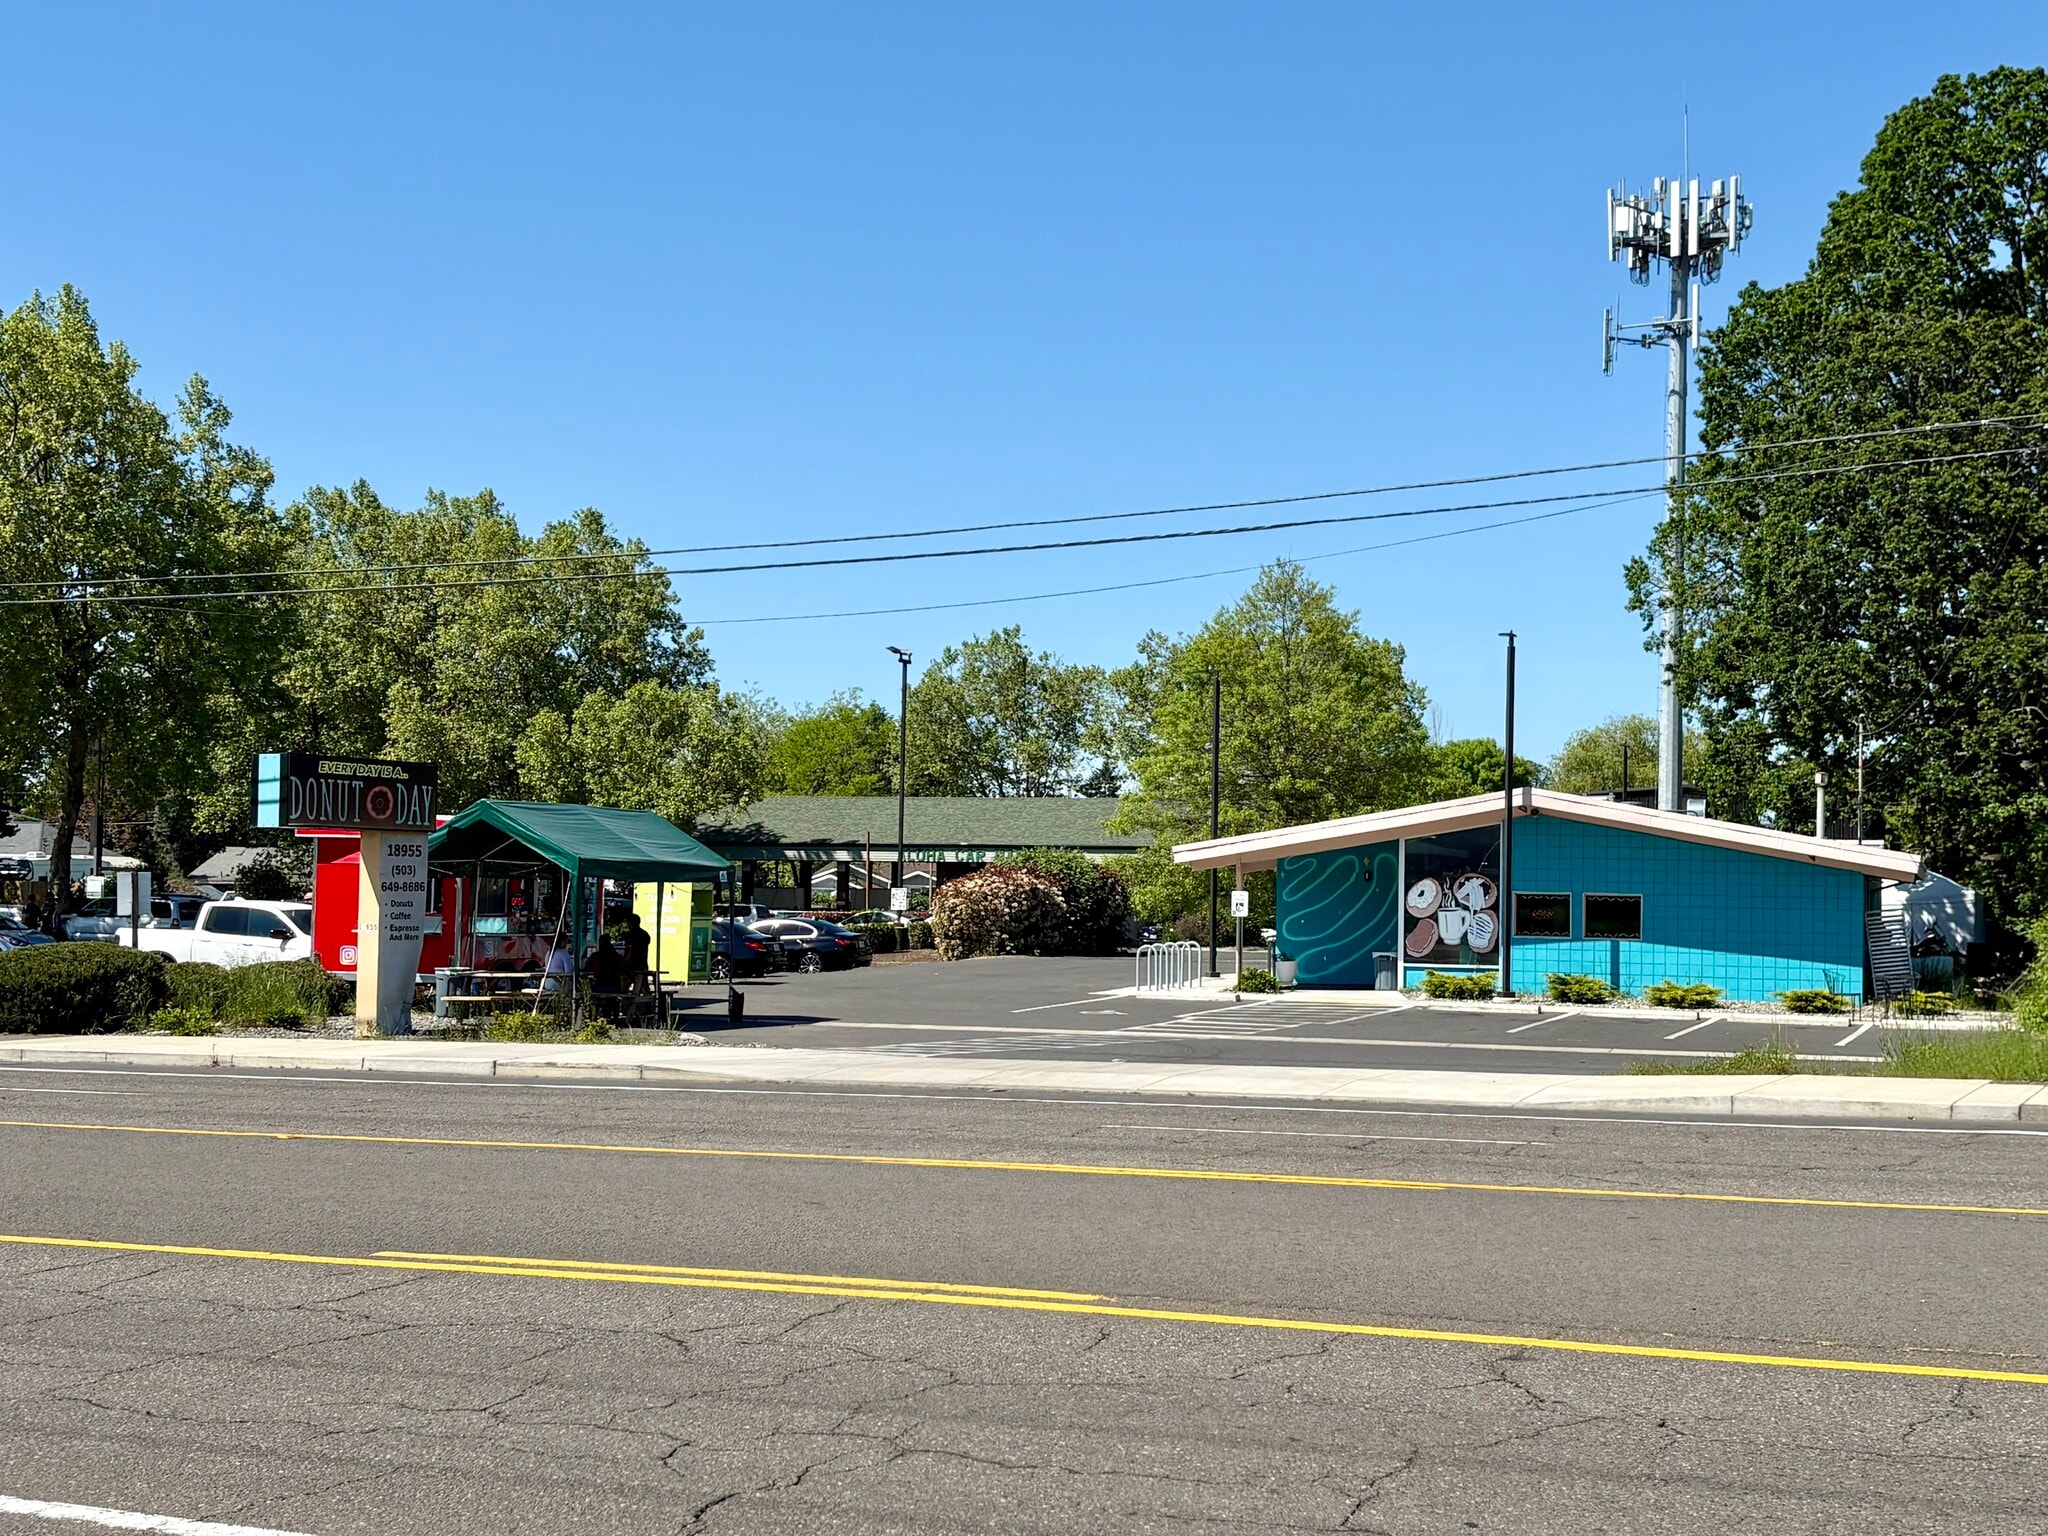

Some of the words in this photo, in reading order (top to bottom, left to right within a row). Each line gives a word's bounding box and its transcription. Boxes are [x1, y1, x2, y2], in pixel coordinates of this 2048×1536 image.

[318, 760, 356, 775] EVERY
[356, 764, 381, 777] DAY
[381, 765, 394, 778] IS
[289, 776, 364, 822] DONUT
[395, 783, 433, 826] DAY
[387, 843, 422, 857] 18955
[955, 849, 986, 862] CAR
[391, 865, 416, 878] (503)
[381, 881, 426, 893] 649-8686
[390, 899, 414, 908] Donuts
[390, 912, 412, 920] Coffee
[389, 924, 420, 933] Espresso
